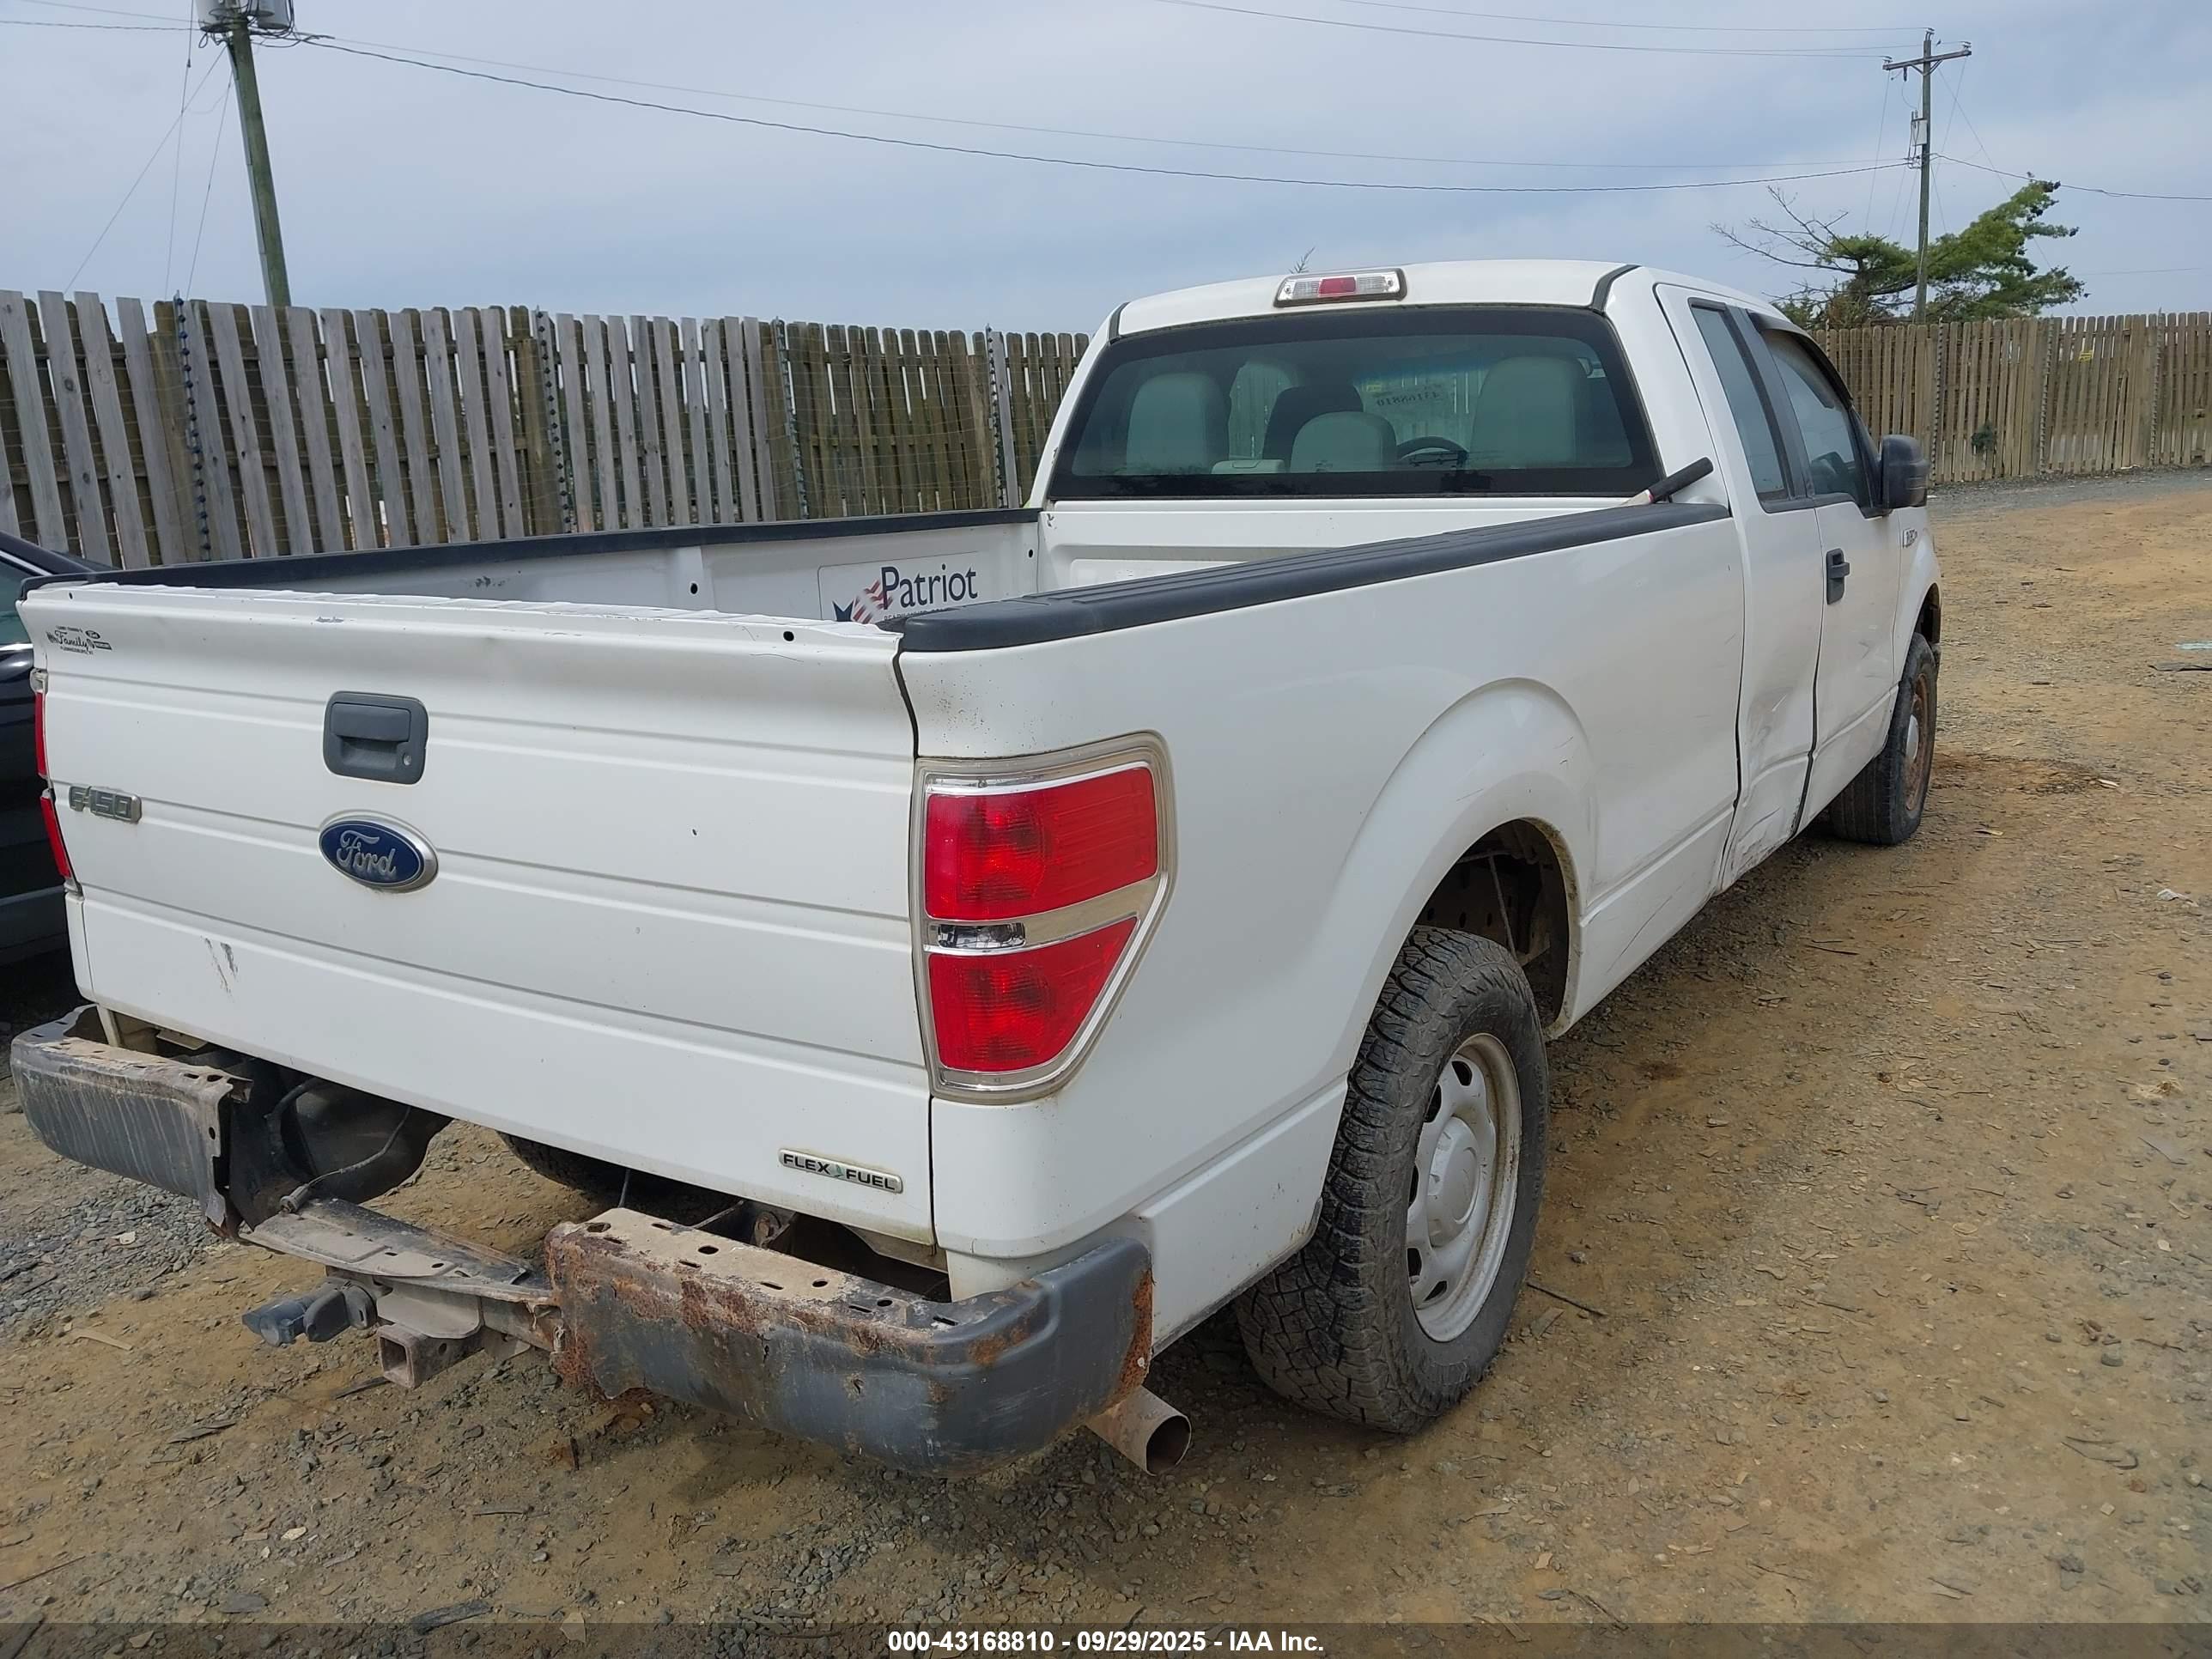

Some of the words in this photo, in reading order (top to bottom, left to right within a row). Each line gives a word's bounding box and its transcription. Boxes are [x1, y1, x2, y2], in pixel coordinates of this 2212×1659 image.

[881, 563, 977, 610] Patriot
[54, 630, 89, 651] Family
[70, 786, 134, 822] F-150
[336, 830, 396, 875] Ford
[783, 1153, 830, 1175] FLEX
[846, 1168, 895, 1190] FUEL
